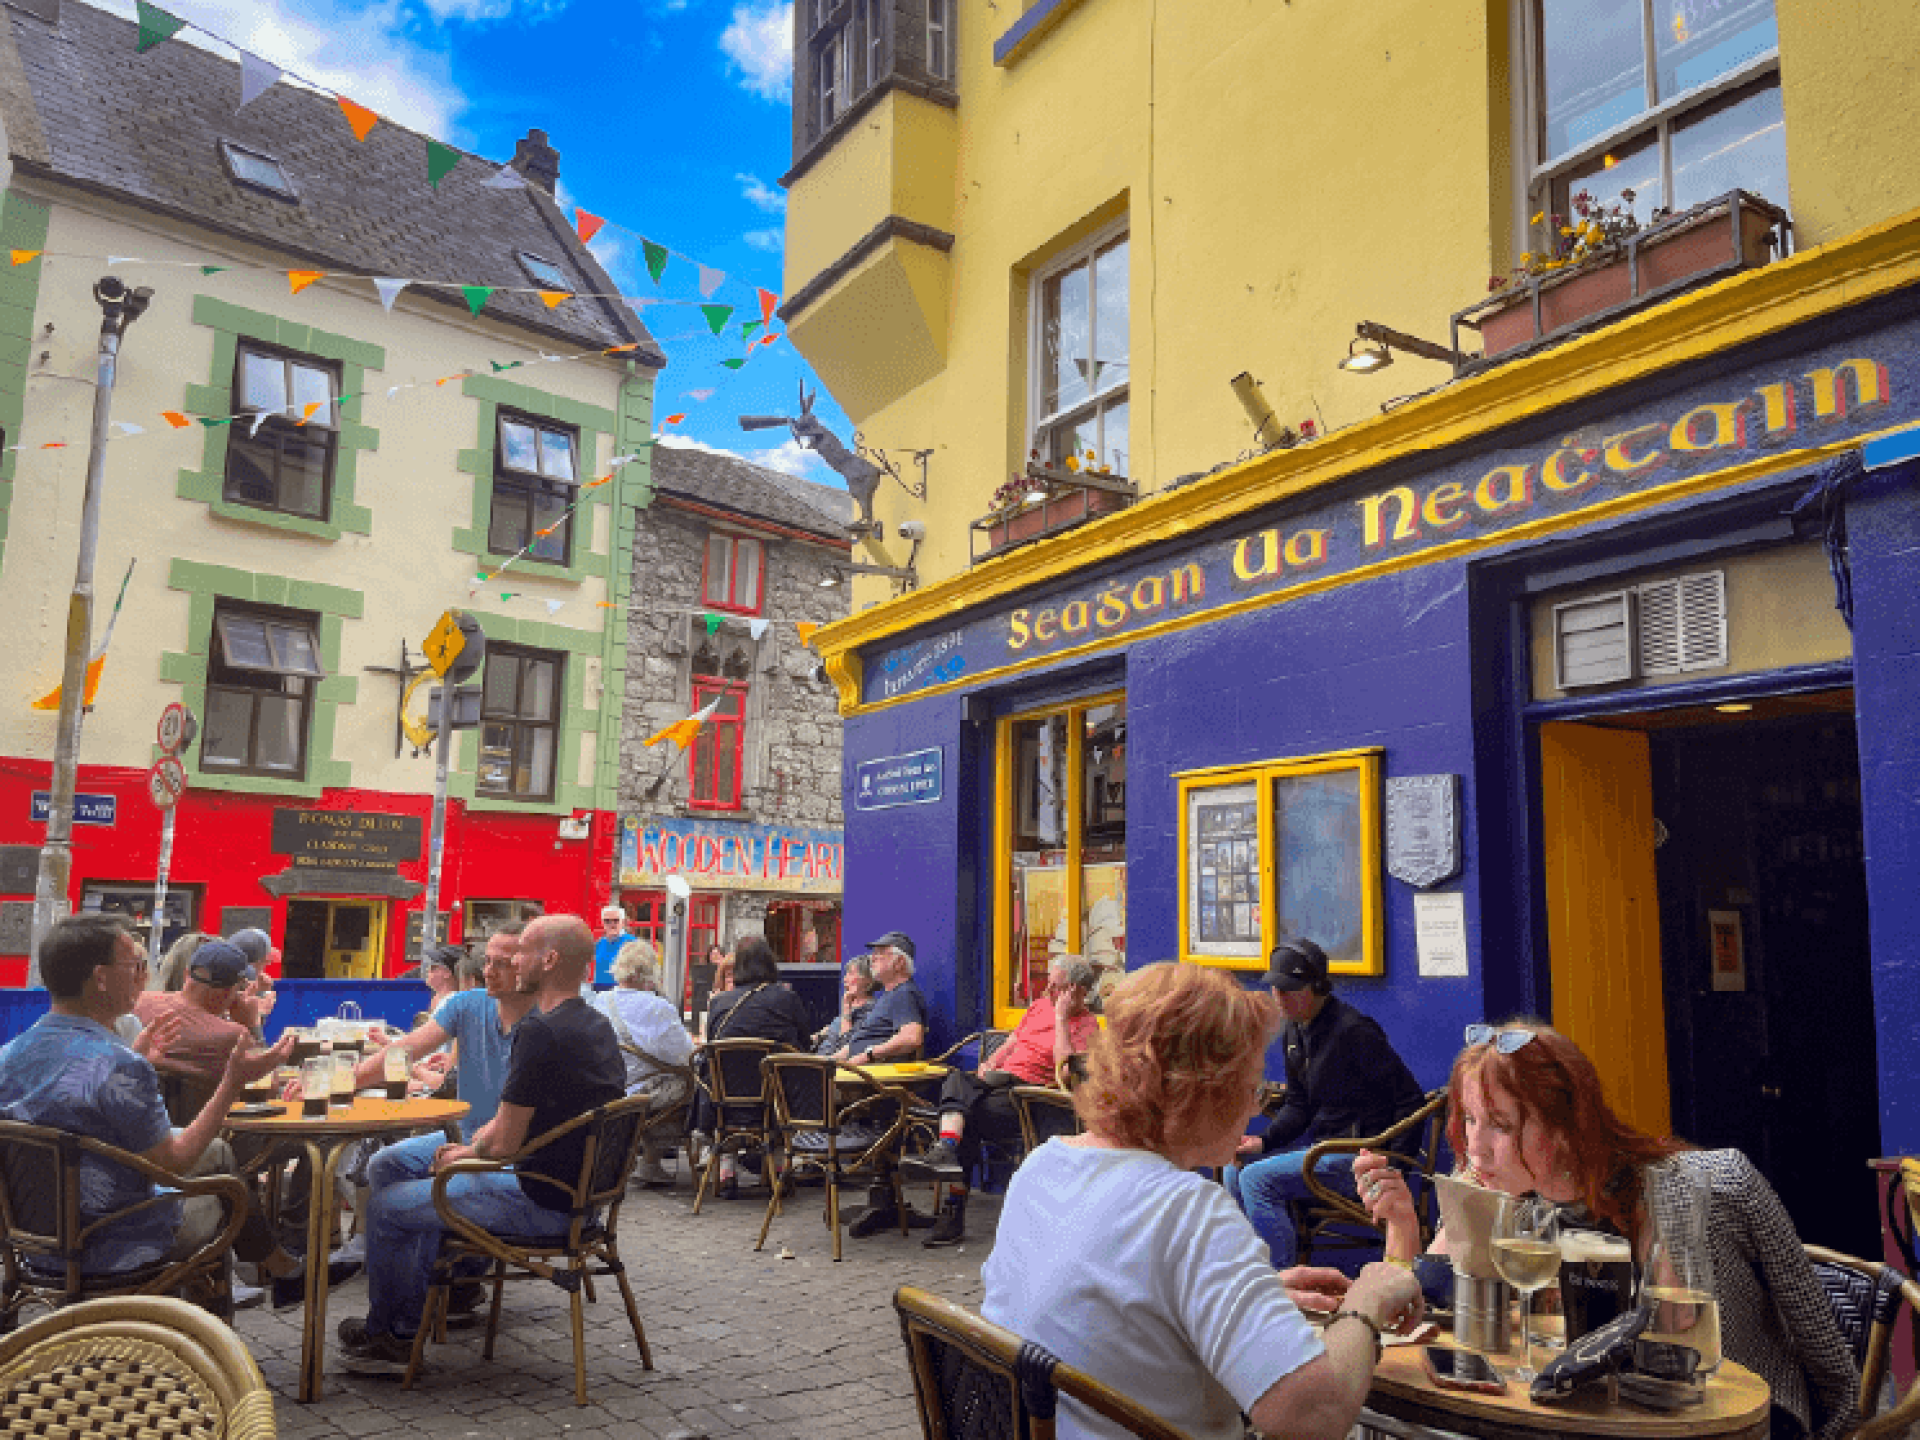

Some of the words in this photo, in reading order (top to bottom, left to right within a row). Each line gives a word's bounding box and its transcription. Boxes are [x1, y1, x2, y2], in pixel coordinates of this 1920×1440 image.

[1232, 527, 1332, 585] Ua
[636, 828, 753, 875] WOODEN
[763, 836, 844, 880] HEART
